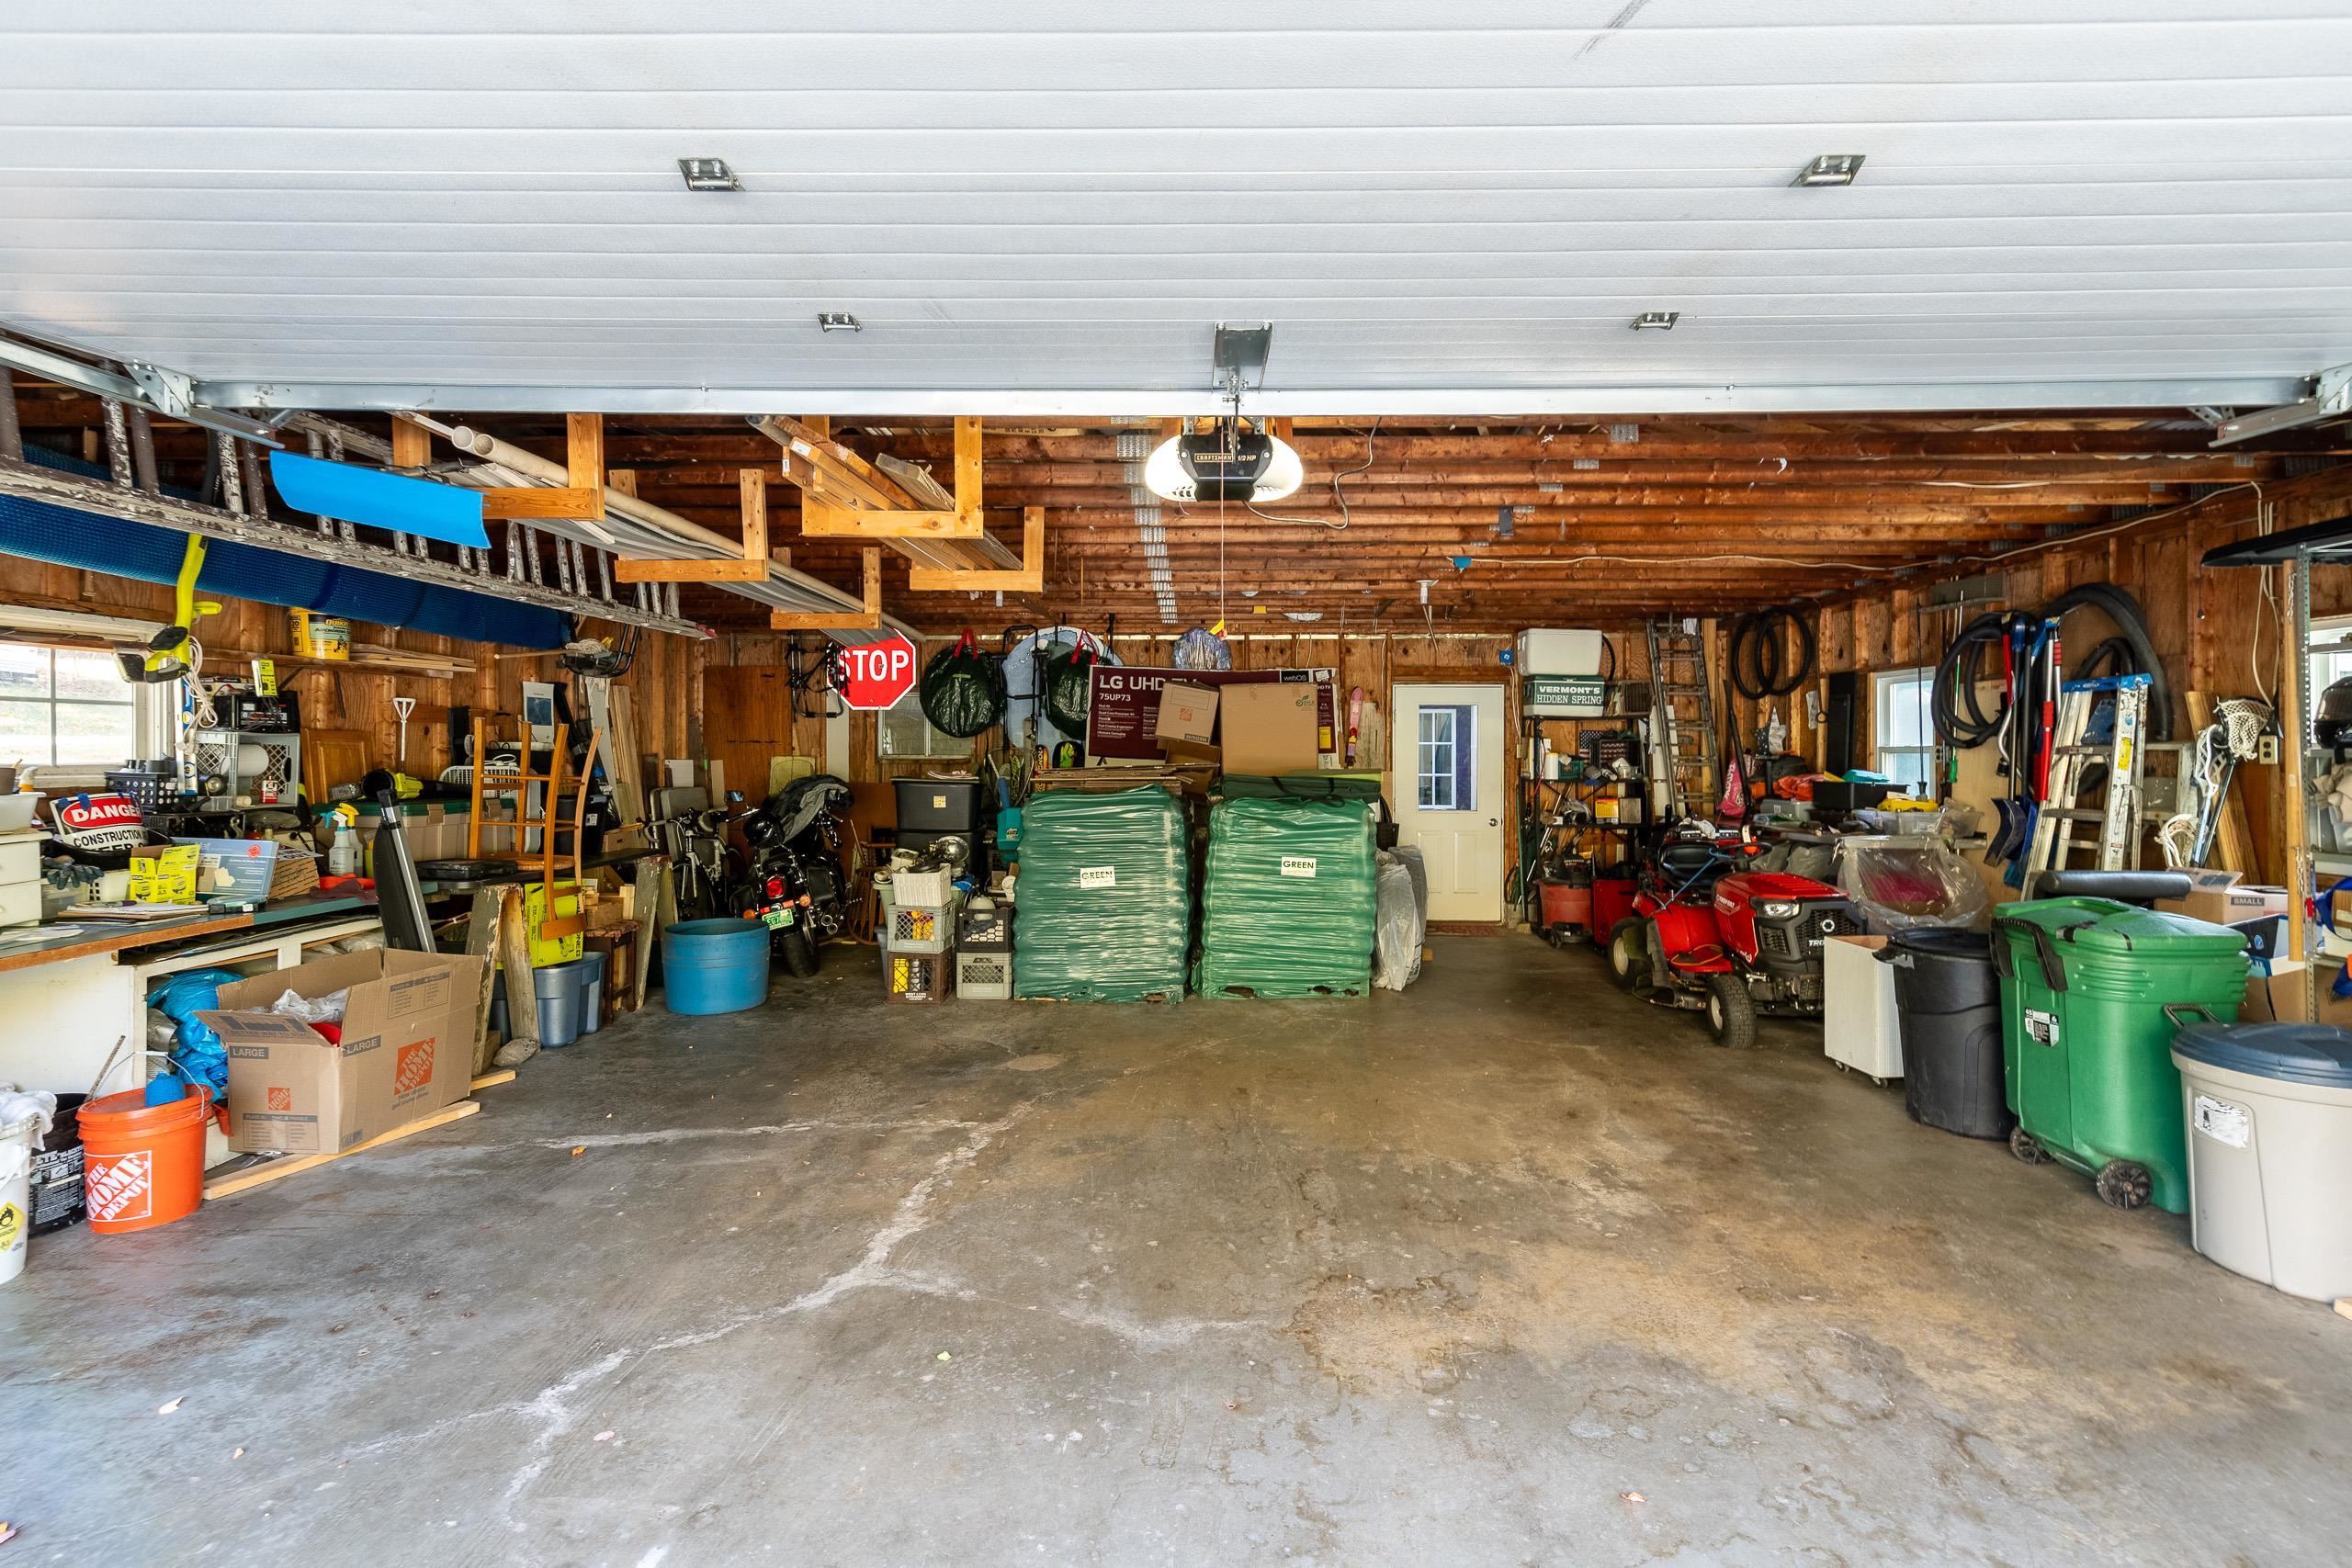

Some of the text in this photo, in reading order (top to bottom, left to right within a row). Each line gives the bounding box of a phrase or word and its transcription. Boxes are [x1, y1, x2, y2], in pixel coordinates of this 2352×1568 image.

[839, 649, 909, 682] STOP
[1099, 674, 1166, 691] LG UHD
[1539, 685, 1600, 694] VERMONT'S
[1099, 693, 1131, 702] 75UP73
[1536, 694, 1603, 705] HIDDEN SPRING
[71, 805, 141, 822] DANGER
[74, 829, 142, 848] CONSTRUCTION
[1283, 861, 1314, 869] GREEN
[1081, 871, 1113, 880] GREEN
[232, 1048, 266, 1057] LARGE
[346, 1038, 378, 1055] LARGE
[395, 1038, 435, 1093] HOME
[401, 1047, 418, 1068] THE
[87, 1163, 108, 1188] THE
[86, 1154, 149, 1220] HOME
[100, 1175, 149, 1221] DEPOT
